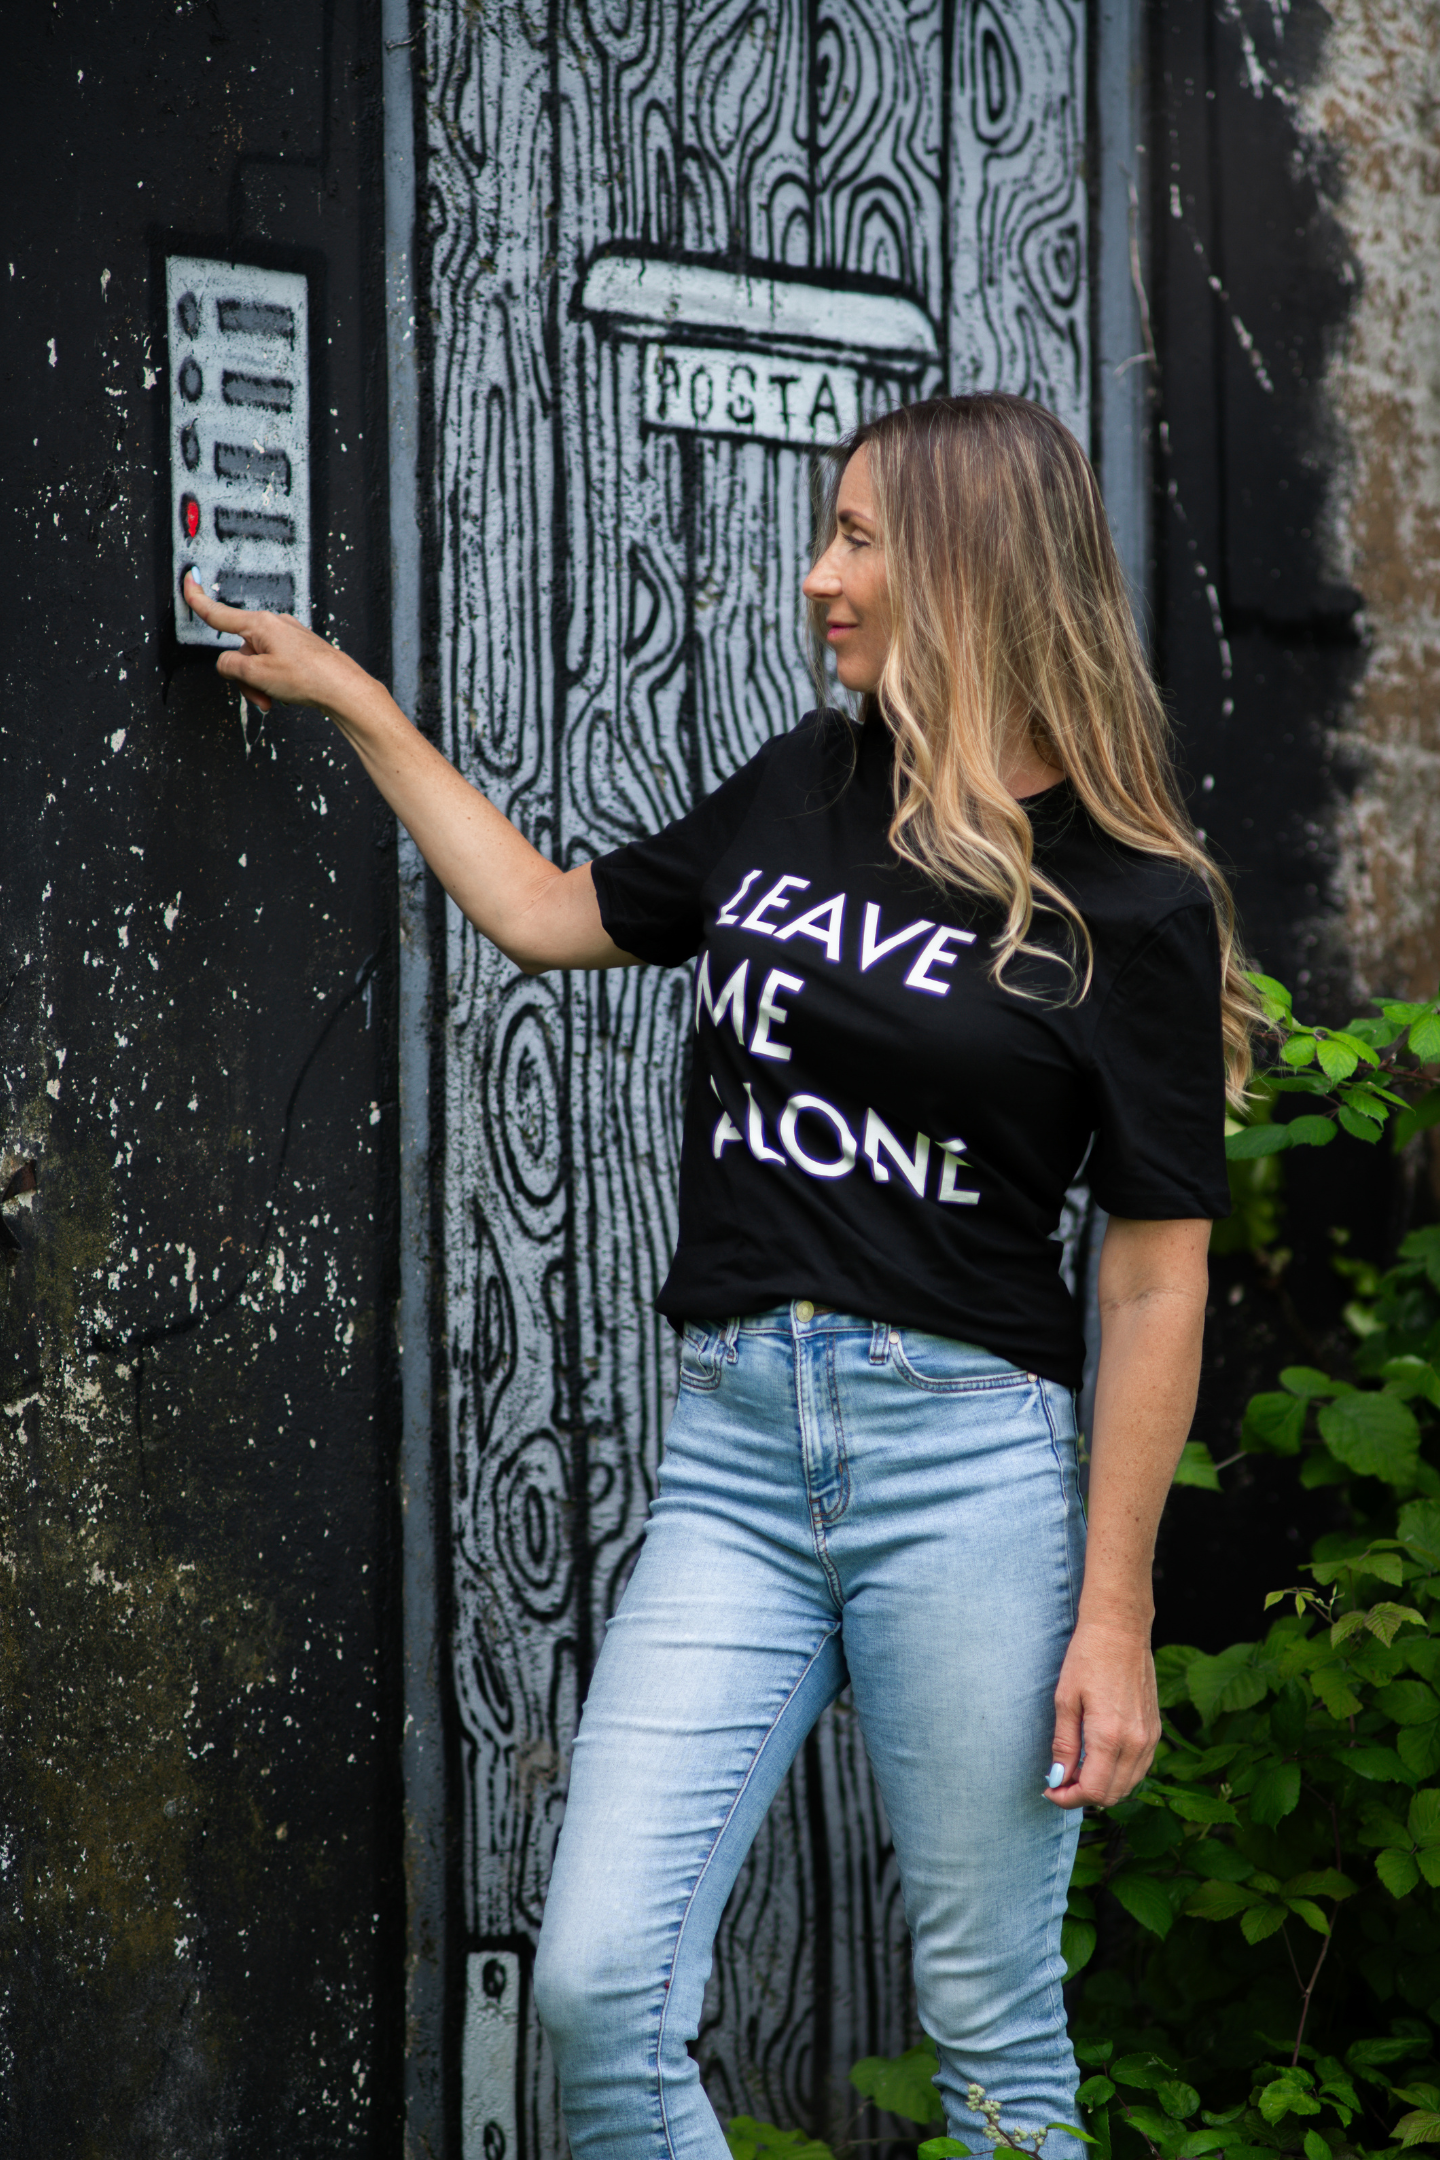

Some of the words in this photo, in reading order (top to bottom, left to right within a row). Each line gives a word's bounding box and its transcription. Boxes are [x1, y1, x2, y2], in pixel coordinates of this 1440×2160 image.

[657, 356, 842, 438] POSTA
[716, 869, 977, 995] LEAVE
[695, 949, 805, 1061] ME
[710, 1074, 981, 1205] ALONE
